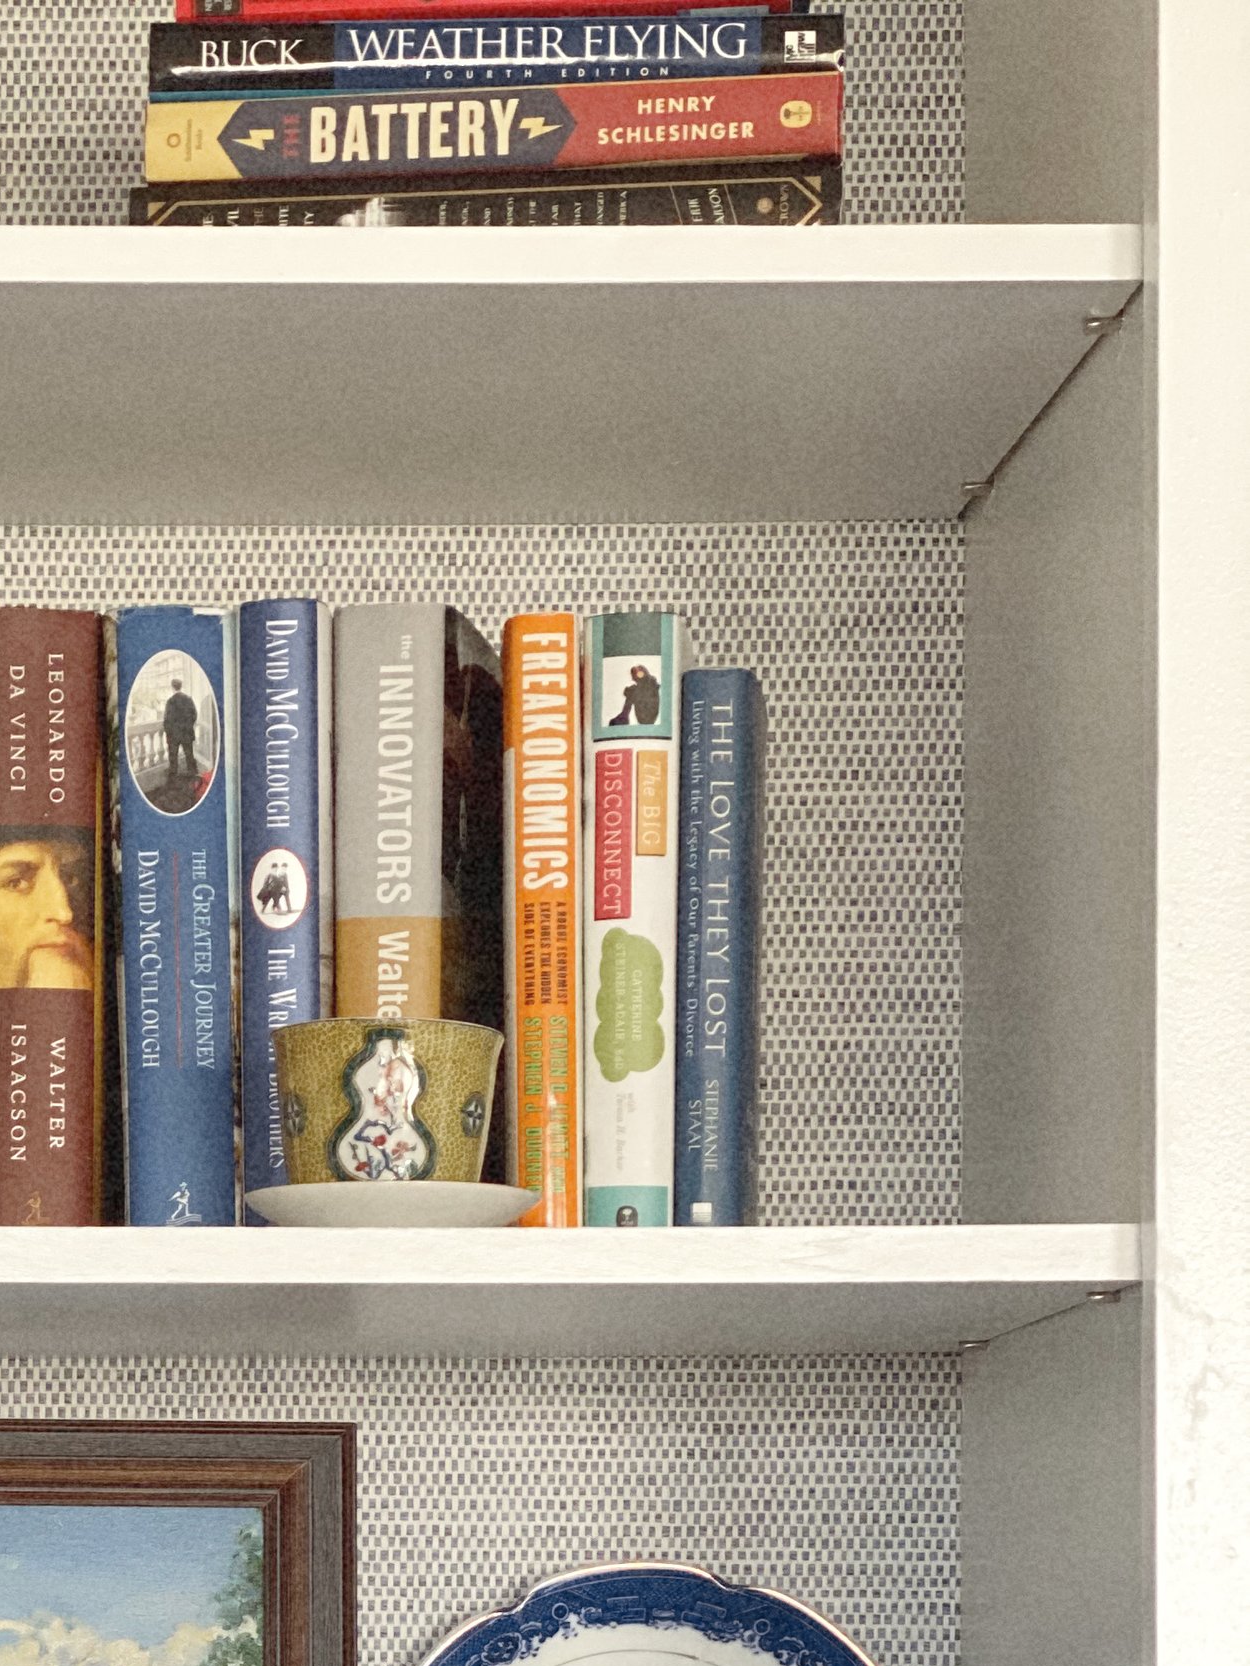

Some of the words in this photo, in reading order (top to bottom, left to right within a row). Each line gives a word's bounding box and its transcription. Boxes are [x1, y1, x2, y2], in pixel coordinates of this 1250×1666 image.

[200, 39, 304, 68] BUCK
[348, 26, 567, 63] WEATHER
[584, 22, 748, 60] FLYING
[426, 68, 533, 80] FOURTH
[561, 66, 669, 78] EDITION
[281, 114, 299, 158] THE
[310, 98, 520, 164] BATTERY
[597, 121, 755, 146] SCHLESINGER
[638, 95, 716, 116] HENRY
[265, 619, 299, 681] DAVID
[400, 634, 414, 661] the
[9, 665, 26, 699] DA
[9, 712, 26, 792] VINCI
[48, 653, 65, 804] LEONARDO
[687, 701, 705, 745] Living
[710, 700, 734, 763] THE
[376, 665, 414, 905] INNOVATORS
[522, 632, 569, 891] FREAKONOMICS
[643, 760, 662, 800] The
[690, 749, 703, 784] with
[643, 805, 661, 848] BIG
[690, 790, 703, 814] the
[708, 781, 734, 862] LOVE
[604, 752, 623, 915] DISCONNECT
[138, 849, 160, 914] DAVID
[192, 849, 207, 881] THE
[689, 876, 701, 893] of
[192, 882, 215, 975] GREATER
[689, 897, 700, 928] Our
[706, 876, 730, 963] THEY
[267, 944, 295, 981] THE
[377, 930, 410, 1019] Walte
[190, 979, 218, 1070] JOURNEY
[632, 969, 643, 1042] CATHERINE
[685, 998, 698, 1057] Divorce
[704, 979, 730, 1057] LOST
[524, 1016, 543, 1095] STEPHEN
[549, 1015, 568, 1077] STEVEN
[9, 1024, 27, 1161] ISAACSON
[49, 1037, 66, 1149] WALTER
[687, 1100, 702, 1152] STAAL
[703, 1079, 720, 1171] STEPHANIE
